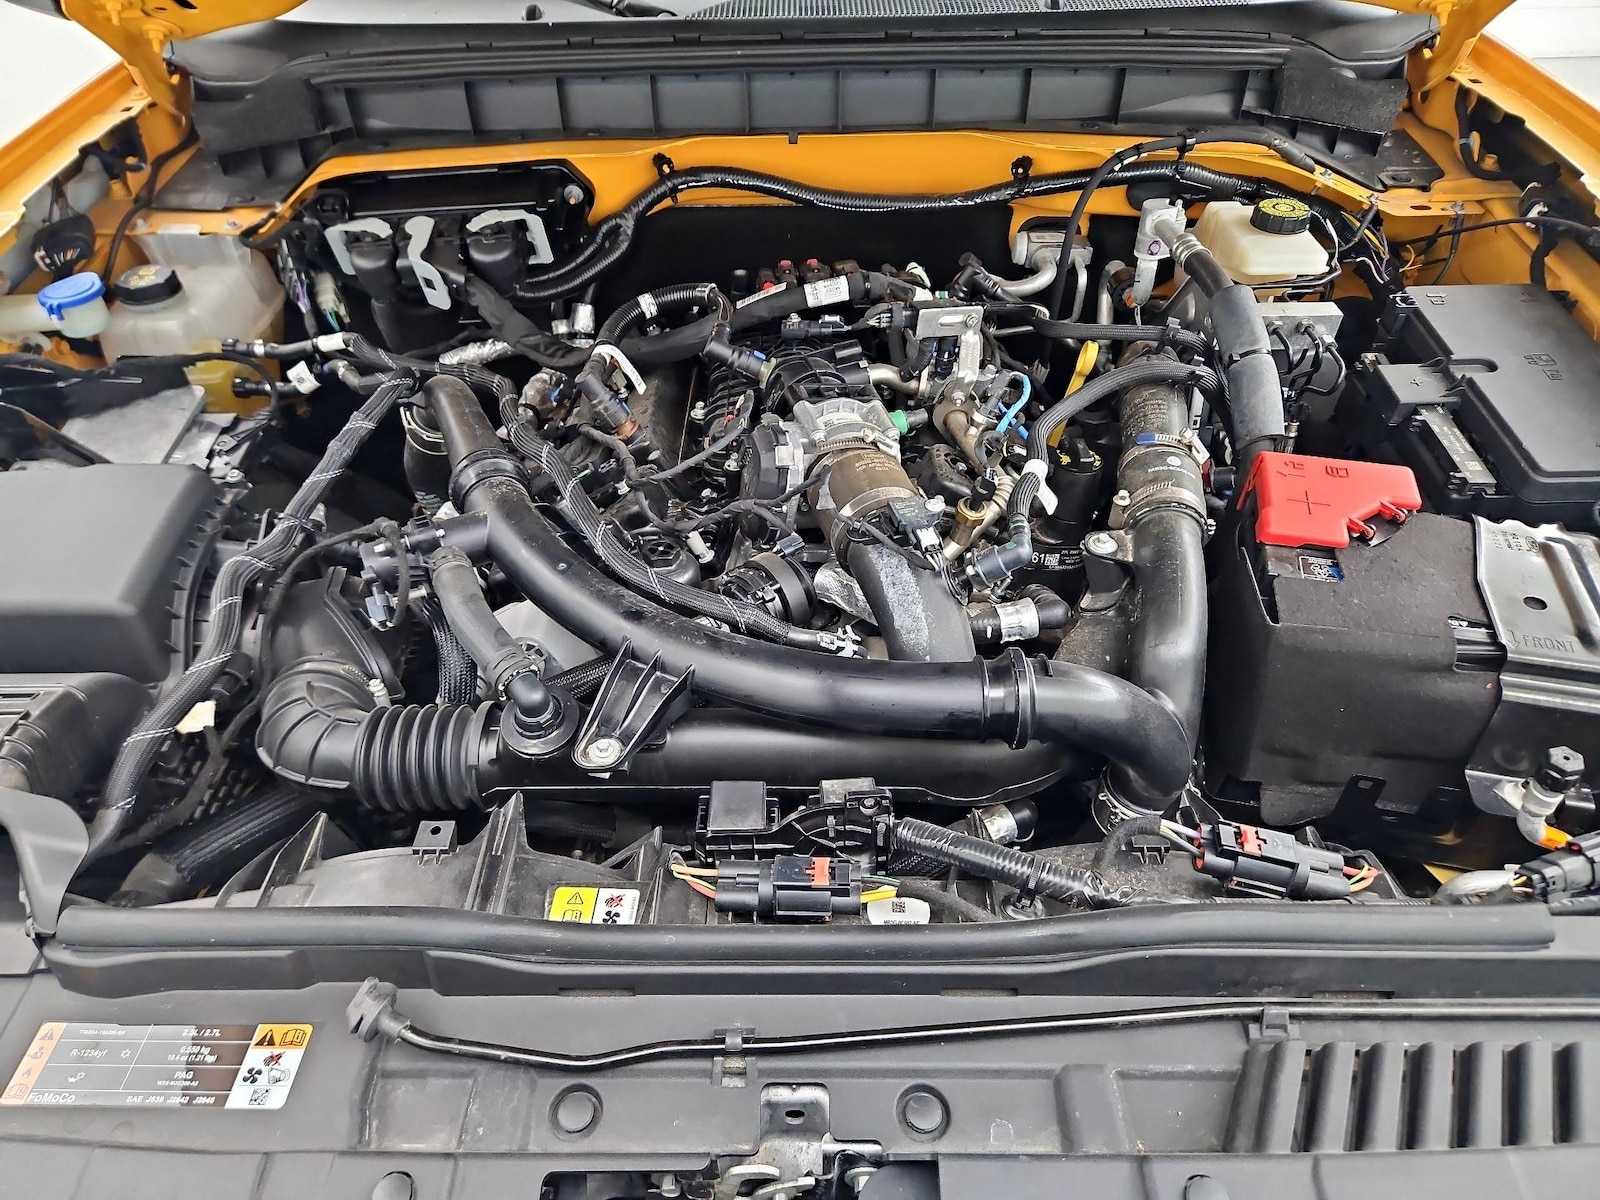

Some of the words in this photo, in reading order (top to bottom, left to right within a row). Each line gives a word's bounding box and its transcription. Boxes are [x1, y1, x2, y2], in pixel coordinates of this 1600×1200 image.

[1522, 634, 1575, 653] FRONT
[204, 1028, 221, 1036] 2.7L
[70, 1049, 108, 1058] R-1234yf
[200, 1046, 211, 1055] kg
[174, 1071, 194, 1079] PAG
[27, 1093, 76, 1103] FoMoCo
[126, 1095, 144, 1103] SAE
